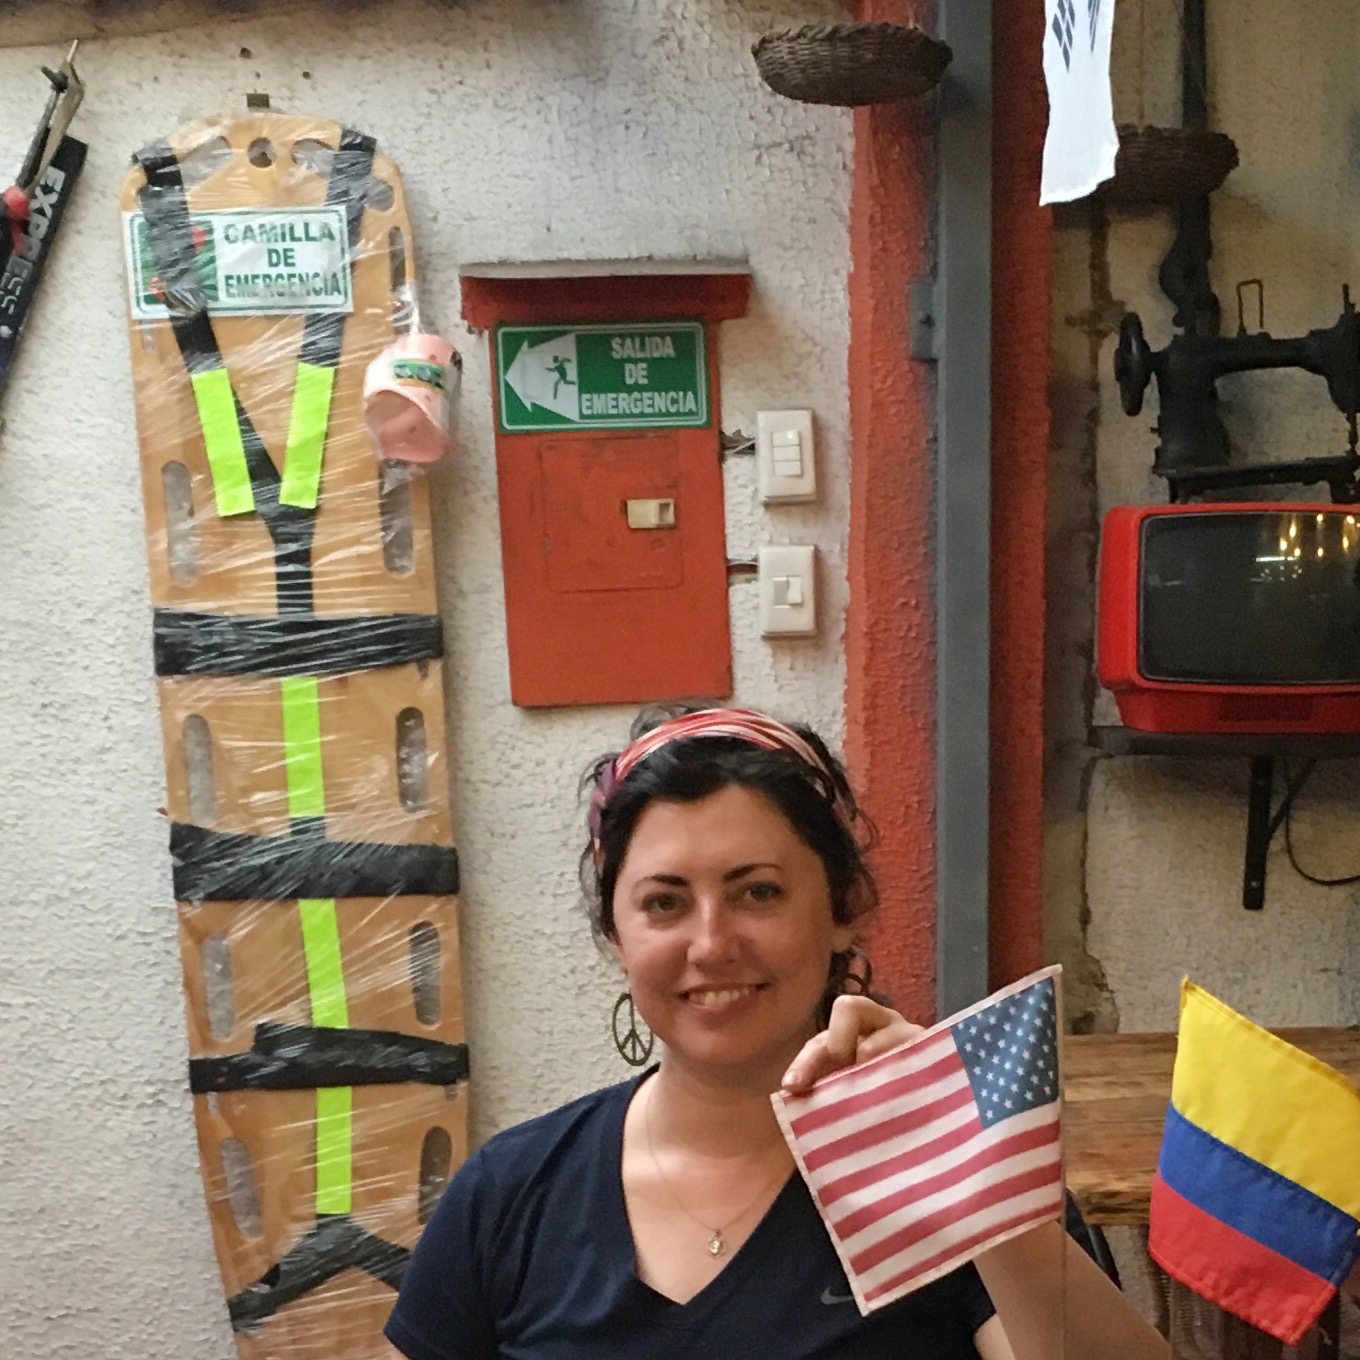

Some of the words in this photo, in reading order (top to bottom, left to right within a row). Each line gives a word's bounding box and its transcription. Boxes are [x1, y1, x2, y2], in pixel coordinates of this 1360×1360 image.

[223, 221, 336, 244] CAMILLA
[267, 247, 296, 268] DE
[224, 270, 342, 299] EMERGENCIA
[611, 335, 677, 360] SALIDA
[623, 362, 649, 386] DE
[580, 390, 698, 415] EMERGENCIA
